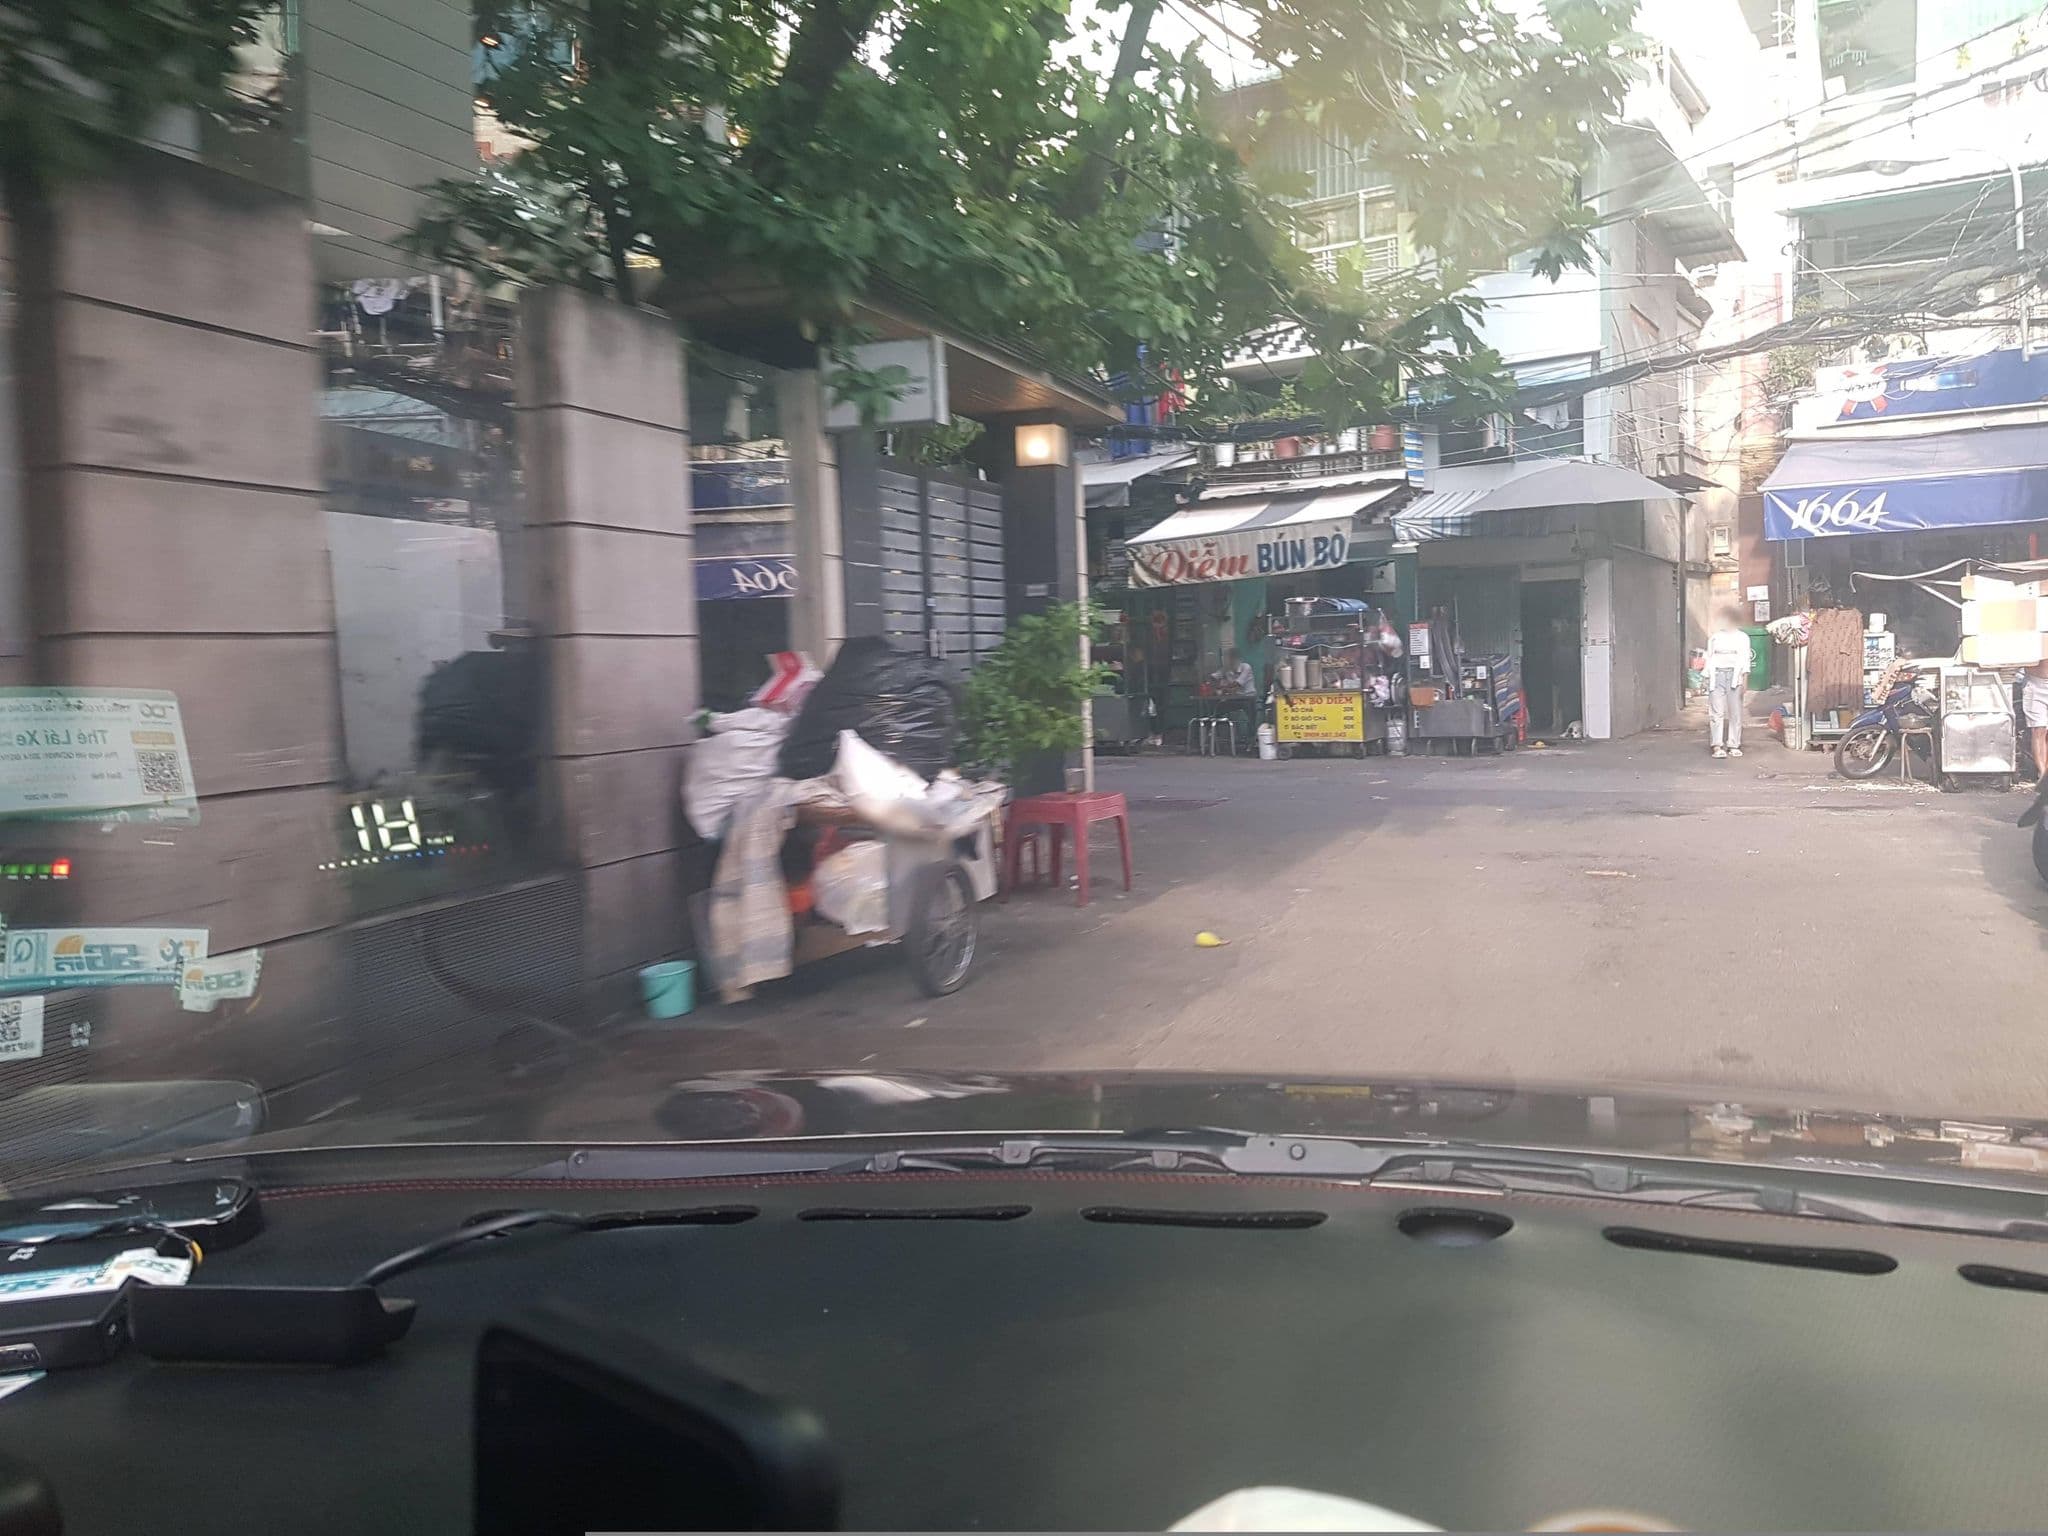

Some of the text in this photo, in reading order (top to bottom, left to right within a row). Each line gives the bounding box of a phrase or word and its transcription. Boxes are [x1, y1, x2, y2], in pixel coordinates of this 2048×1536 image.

[1789, 489, 1889, 530] 1664
[1151, 526, 1347, 582] Diễm BÚN BÒ
